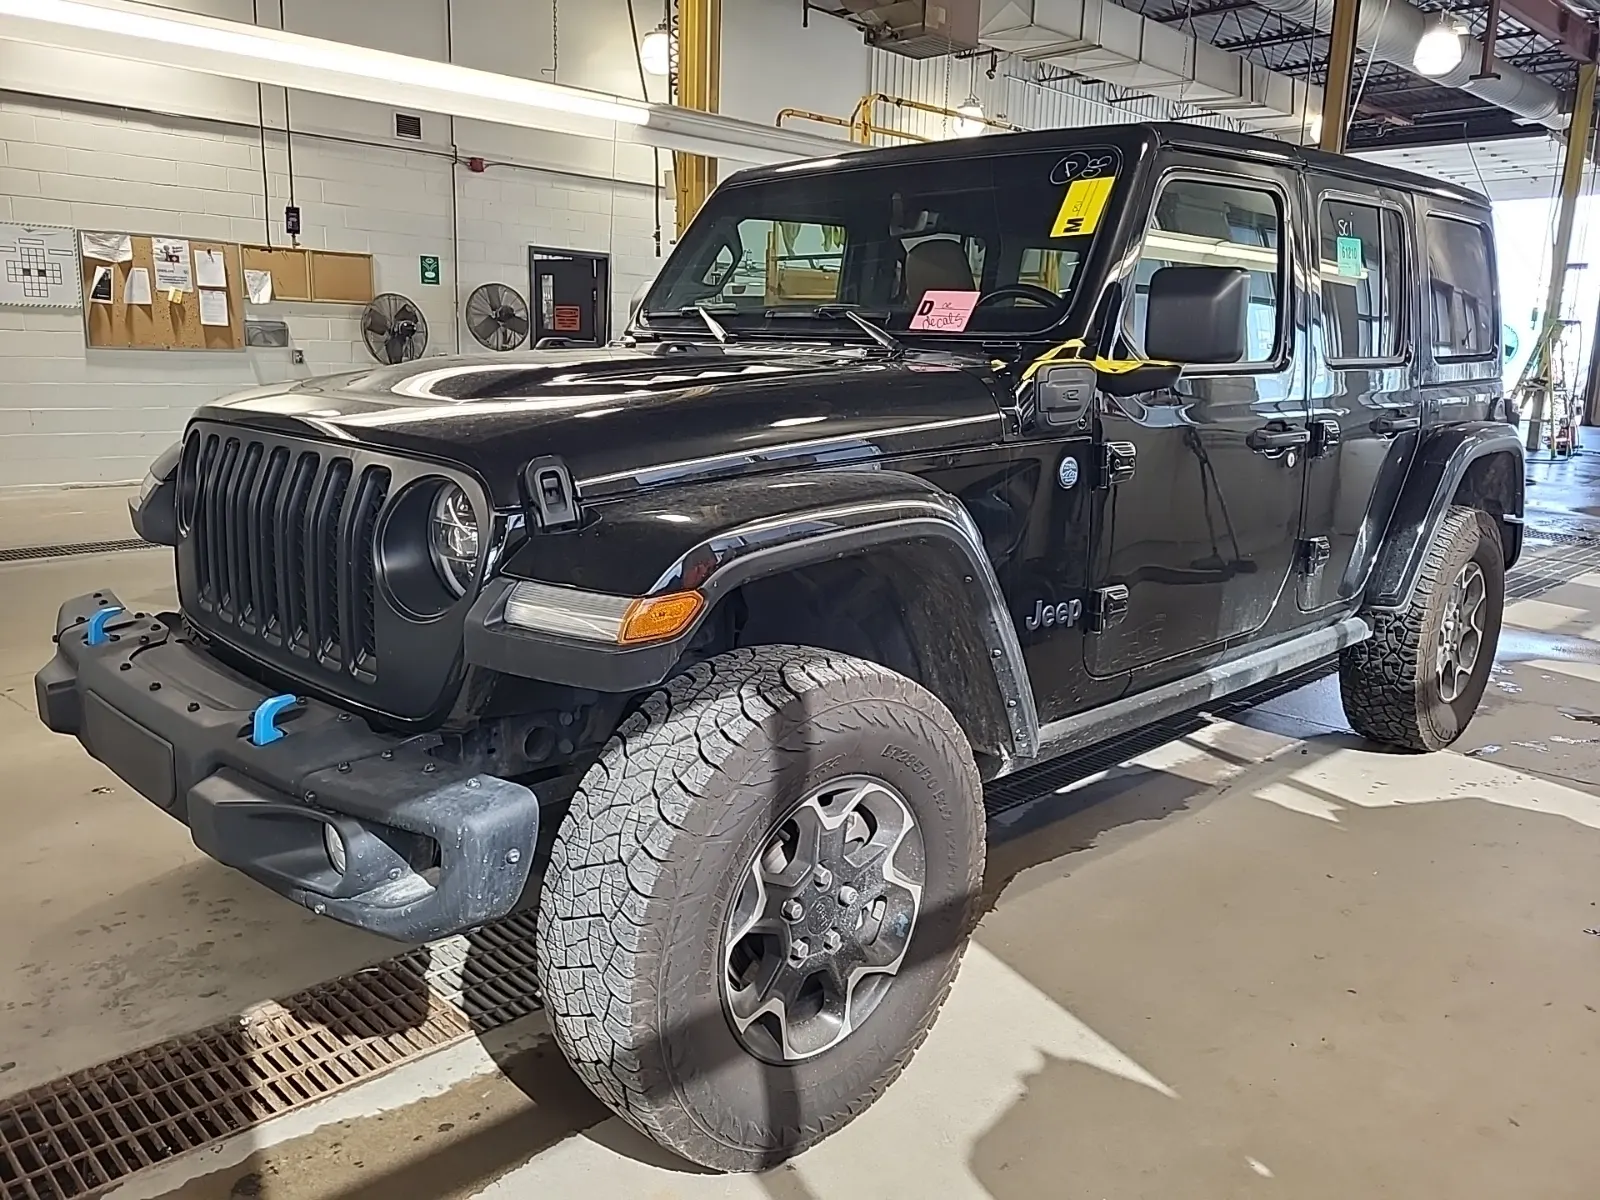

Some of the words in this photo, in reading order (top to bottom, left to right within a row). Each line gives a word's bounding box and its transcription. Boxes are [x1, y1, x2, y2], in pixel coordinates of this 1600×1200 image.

[1063, 217, 1085, 234] M
[918, 299, 935, 316] D
[1025, 598, 1083, 632] Jeep
